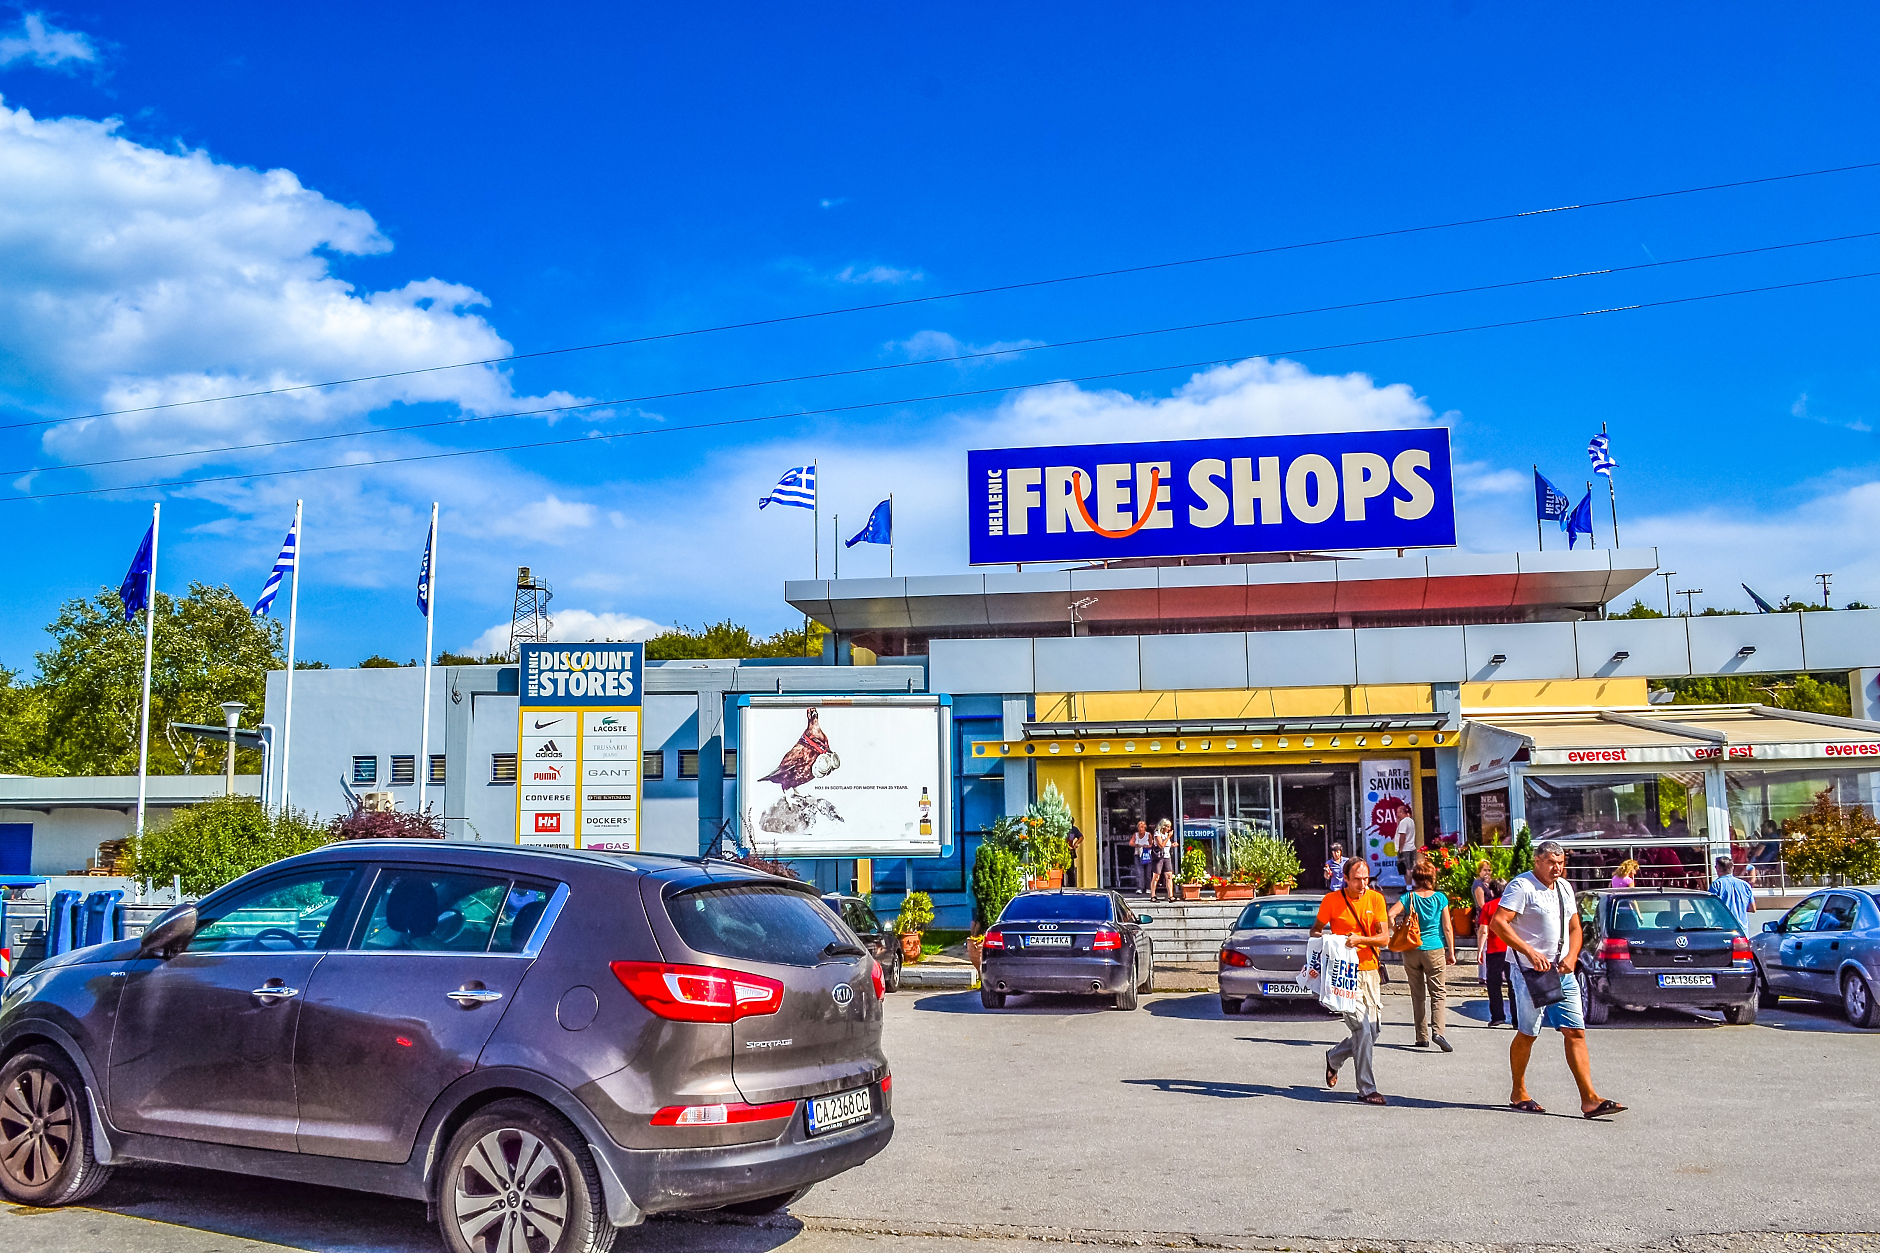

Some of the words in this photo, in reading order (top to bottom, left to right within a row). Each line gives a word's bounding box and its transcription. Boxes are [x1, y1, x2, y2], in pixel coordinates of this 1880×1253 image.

[1007, 461, 1174, 537] FREE
[1188, 449, 1435, 528] SHOPS
[988, 469, 1003, 536] HELLENIC
[540, 651, 634, 671] DISCOUNT
[528, 651, 539, 697] HELLENIC
[540, 671, 633, 697] STORES
[1568, 748, 1627, 762] everest
[534, 772, 556, 780] PUMA
[588, 769, 631, 777] GANT
[1388, 769, 1402, 777] ART
[1370, 777, 1410, 791] SAVING
[605, 842, 630, 850] GAS
[746, 1038, 793, 1049] SPORTAGE
